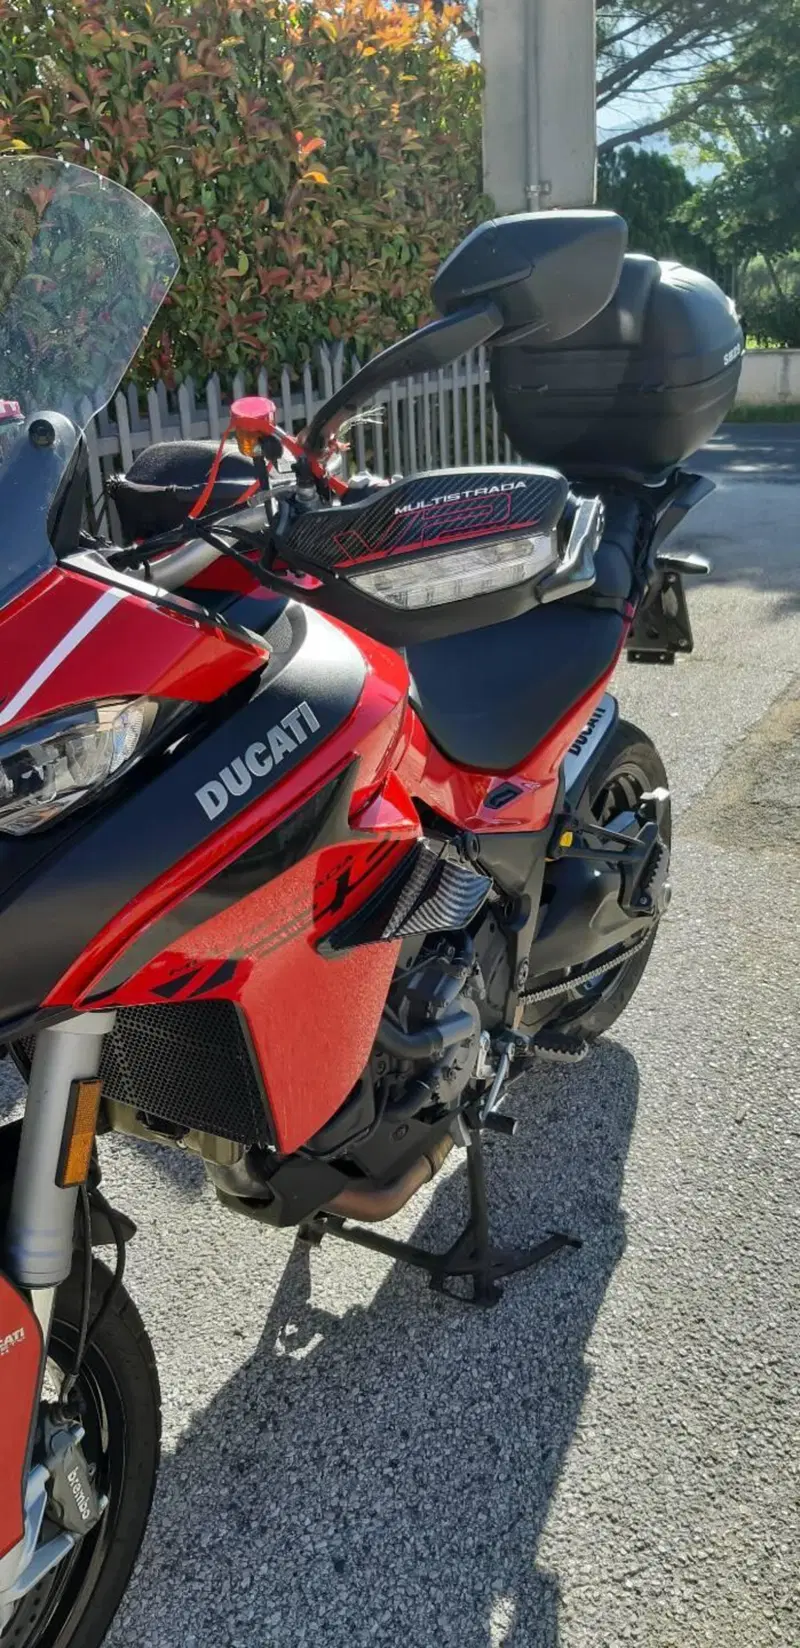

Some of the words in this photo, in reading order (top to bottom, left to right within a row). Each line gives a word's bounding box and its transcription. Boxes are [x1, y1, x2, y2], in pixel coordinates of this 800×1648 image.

[394, 480, 527, 515] MULTISTRADA
[194, 700, 321, 821] DUCATI
[67, 1466, 91, 1520] brembo
